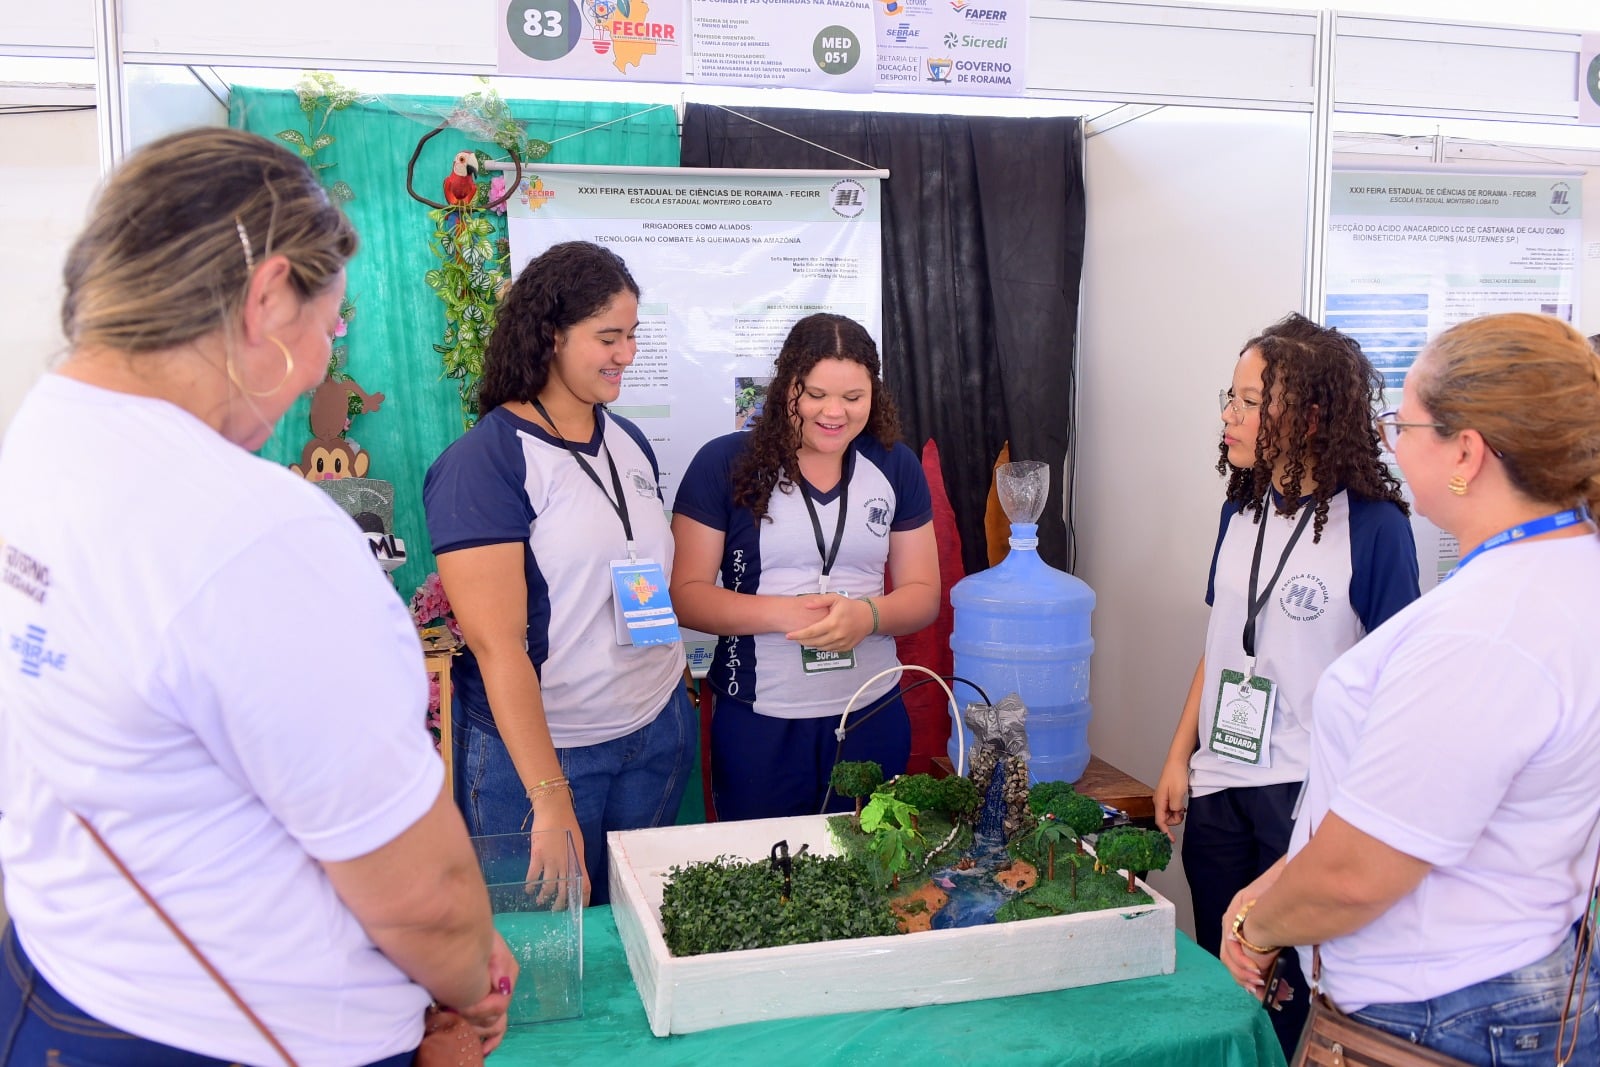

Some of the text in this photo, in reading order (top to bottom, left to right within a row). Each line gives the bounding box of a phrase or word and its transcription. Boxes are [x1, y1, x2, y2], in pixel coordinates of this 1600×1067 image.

[964, 9, 1007, 20] FAPERR
[523, 8, 563, 38] 83
[612, 20, 675, 40] FECIRR
[886, 28, 920, 37] SEBRAE
[822, 37, 852, 49] MED
[962, 34, 1008, 49] Sicredi
[824, 52, 848, 64] 051
[955, 60, 1012, 73] GOVERNO
[880, 74, 918, 82] DESPORTO
[957, 74, 1012, 85] DE RORAIMA
[528, 189, 555, 198] FECIRR
[689, 188, 728, 197] CIÊNCIAS
[1437, 188, 1466, 196] CIÊNCIAS
[368, 534, 406, 559] ML
[1281, 574, 1329, 604] ESCOLA ESTADUAL
[1286, 583, 1319, 612] ML
[1280, 598, 1325, 622] MONTEIRO LOBATO
[816, 651, 839, 661] SOFIA
[1224, 734, 1257, 750] EDUARDA
